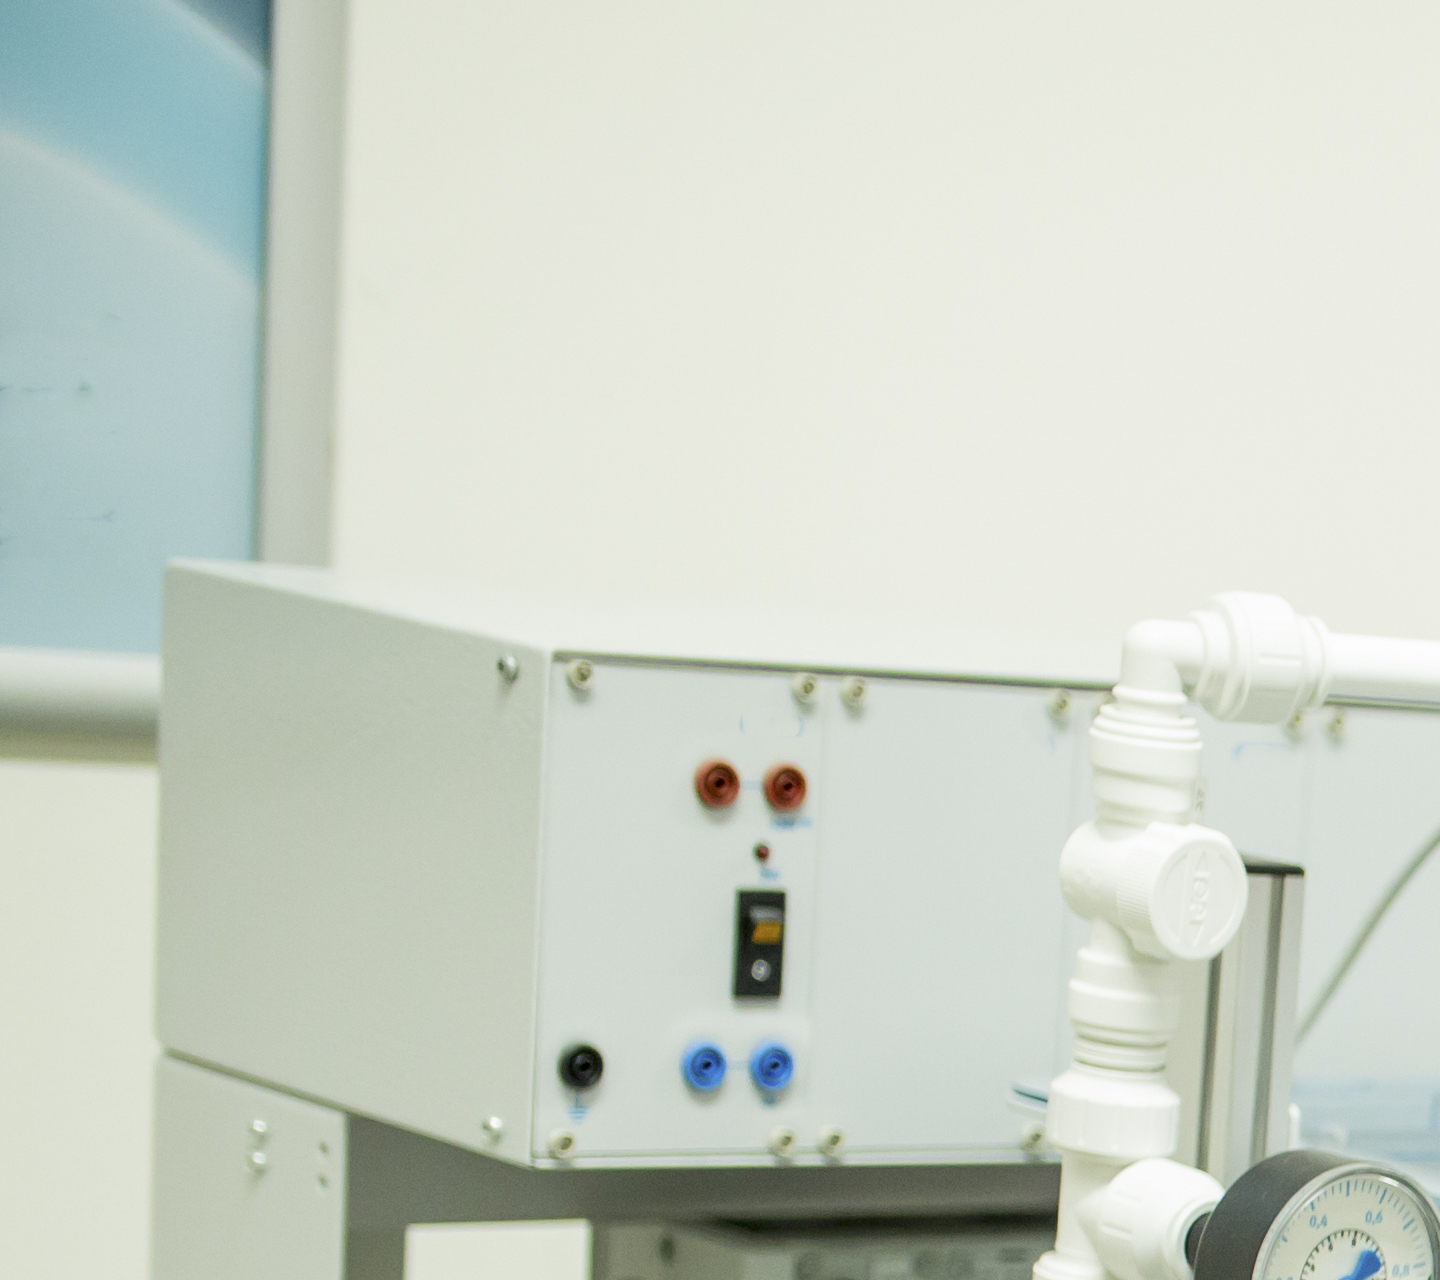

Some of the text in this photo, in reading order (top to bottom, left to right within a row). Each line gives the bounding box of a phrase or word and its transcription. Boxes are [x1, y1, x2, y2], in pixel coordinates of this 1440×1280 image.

[1309, 1214, 1328, 1229] 0,4
[1365, 1210, 1383, 1225] 0,6
[1392, 1264, 1410, 1277] 0,8
